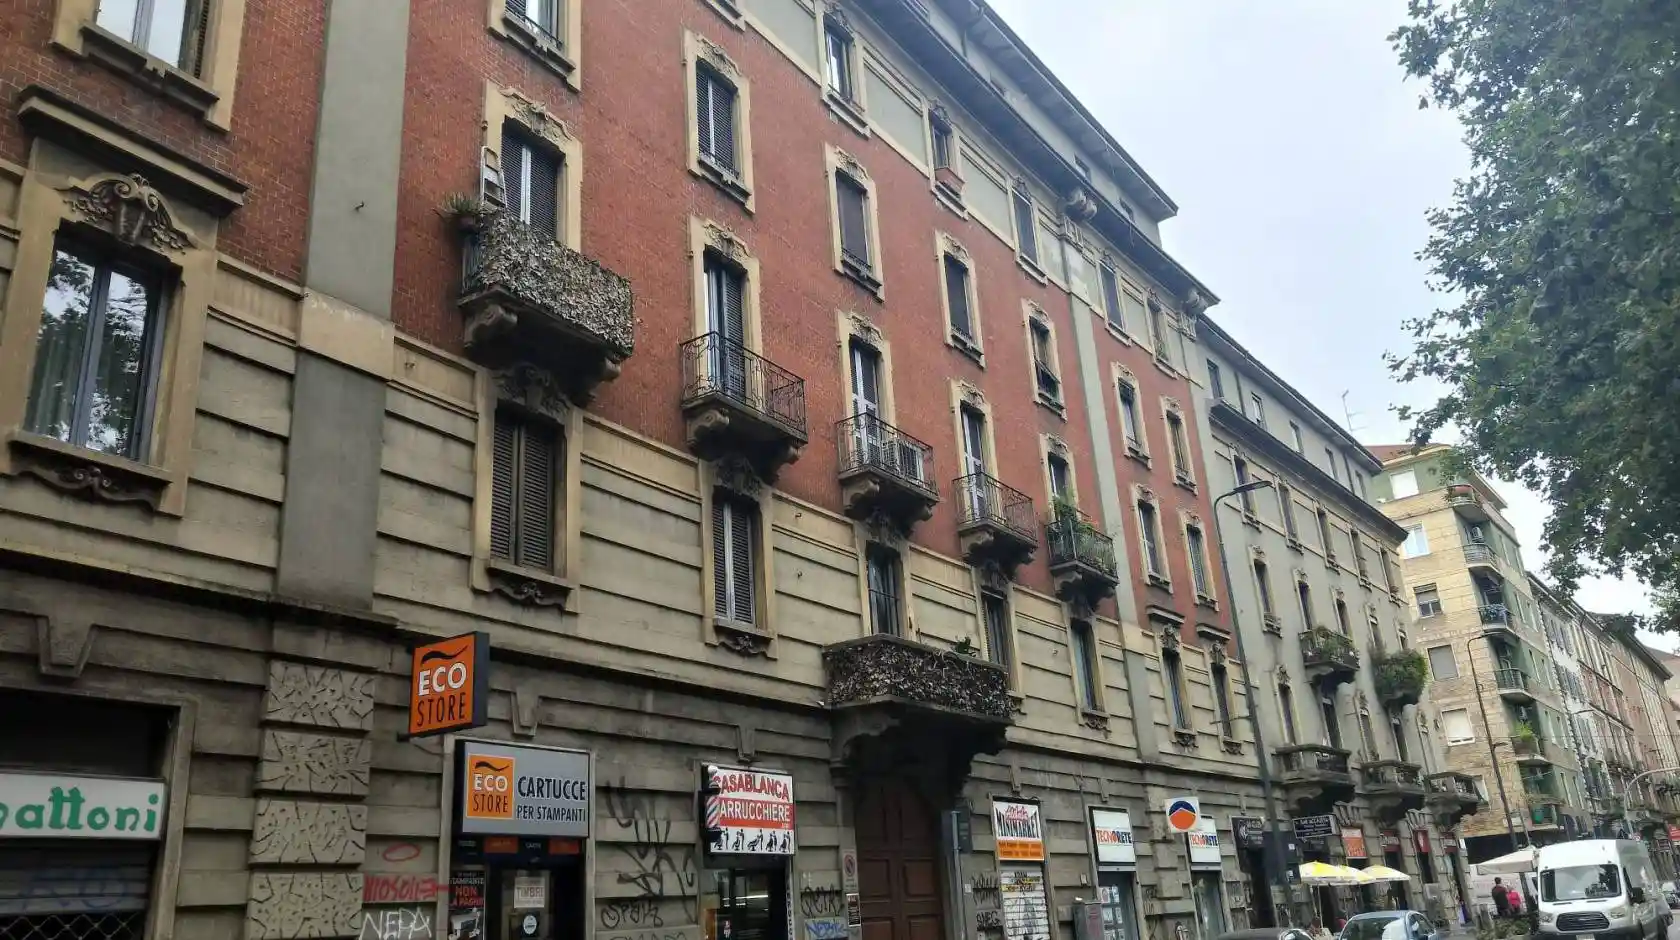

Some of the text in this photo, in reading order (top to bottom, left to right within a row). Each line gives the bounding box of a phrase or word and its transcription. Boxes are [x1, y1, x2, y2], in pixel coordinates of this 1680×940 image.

[418, 662, 467, 696] ECO
[417, 692, 467, 727] STORE
[473, 773, 508, 792] ECO
[517, 776, 586, 801] CARTUCCE
[0, 786, 159, 832] attoni
[473, 794, 508, 813] STORE
[719, 802, 791, 822] ARRUCCHIERE
[516, 805, 586, 822] PER STAMPANTI
[1096, 829, 1132, 844] TECNORETE
[1189, 833, 1219, 847] TECNORETE
